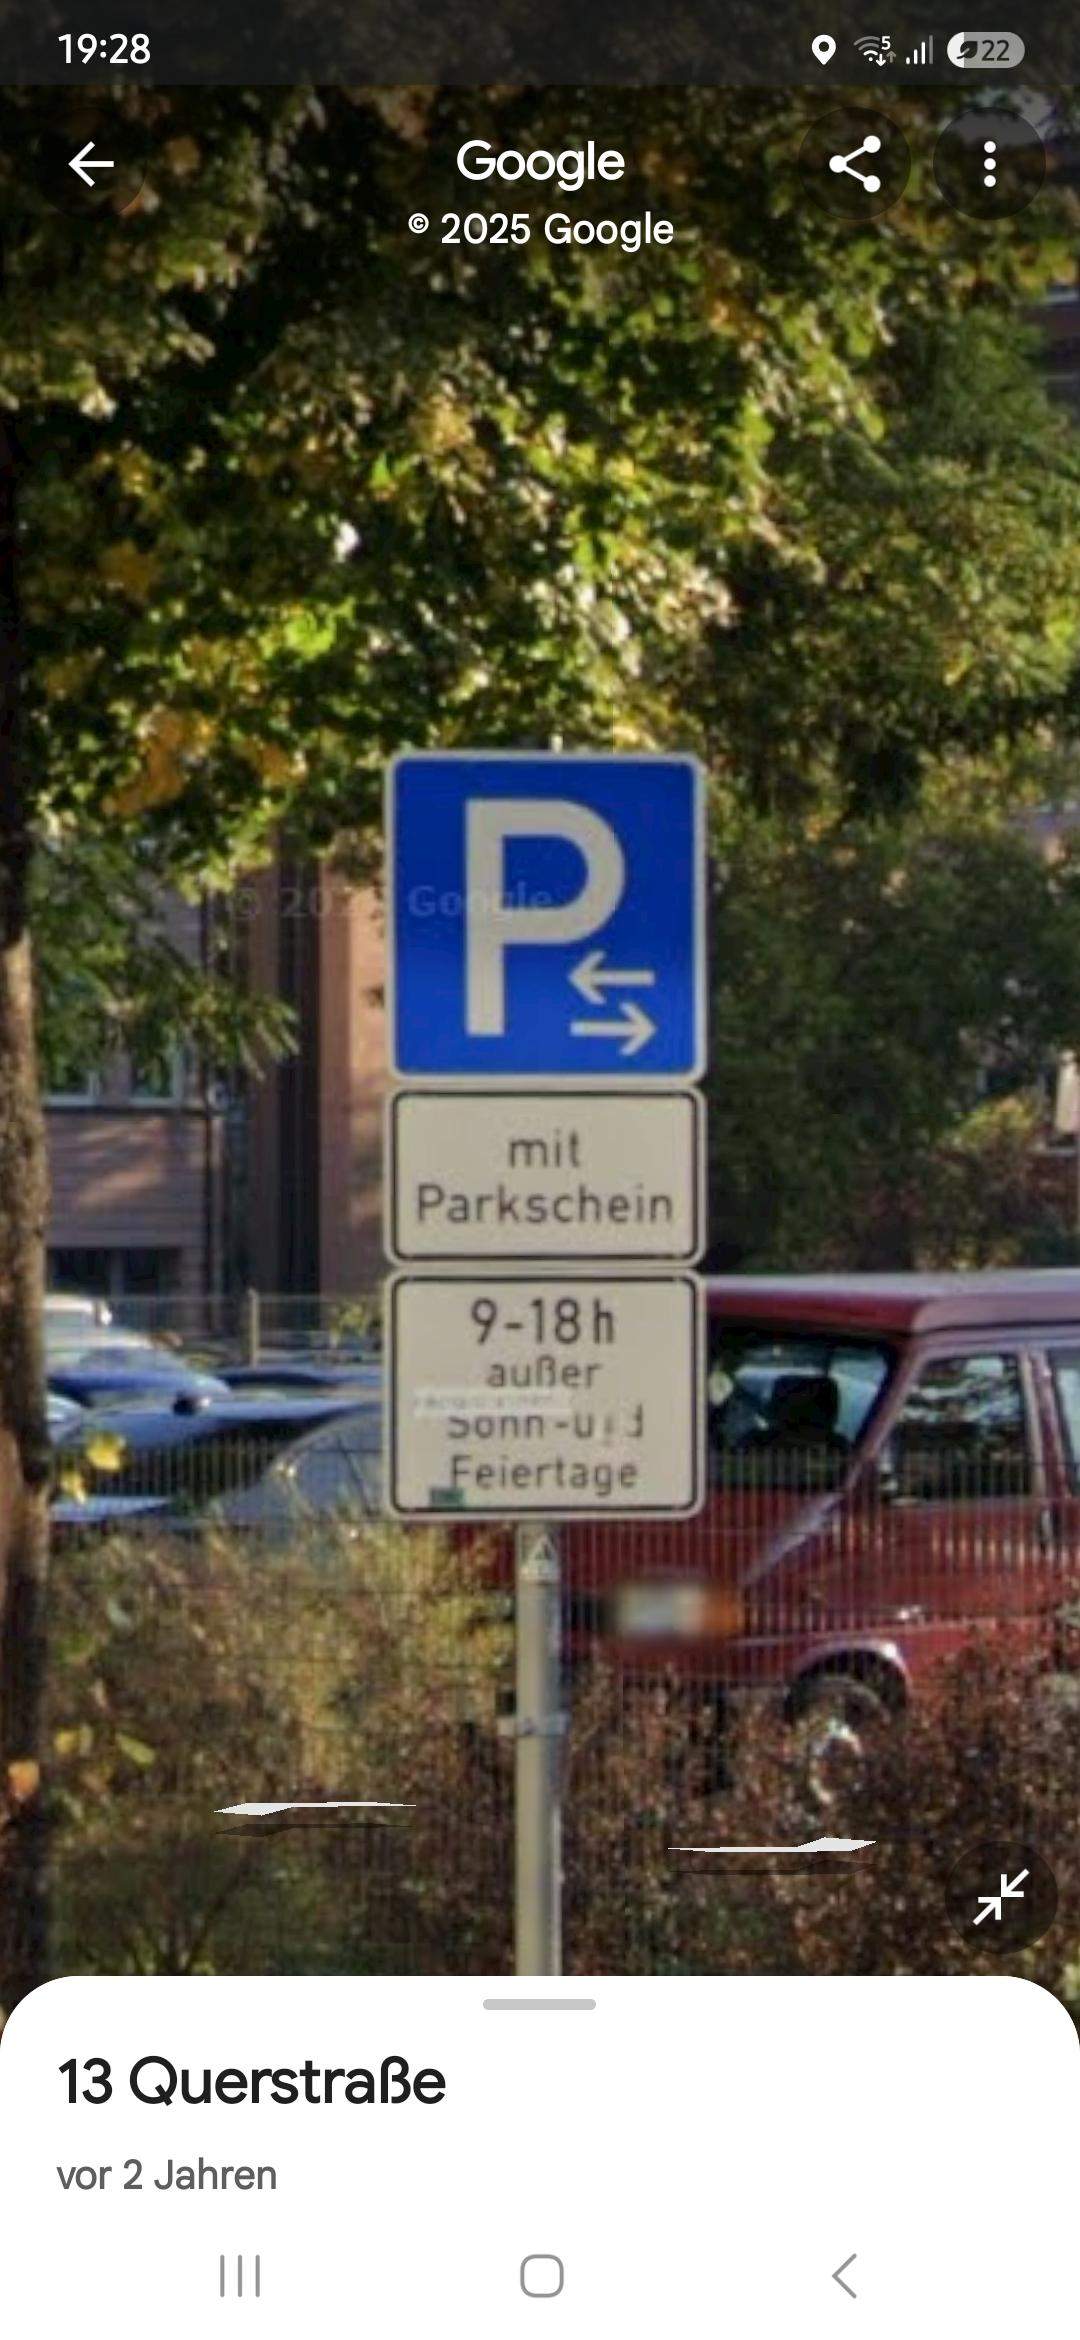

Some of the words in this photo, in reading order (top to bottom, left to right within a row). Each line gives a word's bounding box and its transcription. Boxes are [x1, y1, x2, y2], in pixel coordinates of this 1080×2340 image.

[465, 798, 626, 1038] P
[507, 1130, 581, 1169] mit
[416, 1182, 674, 1226] Parkschein
[486, 1353, 602, 1389] außer
[450, 1453, 639, 1497] Feiertage
